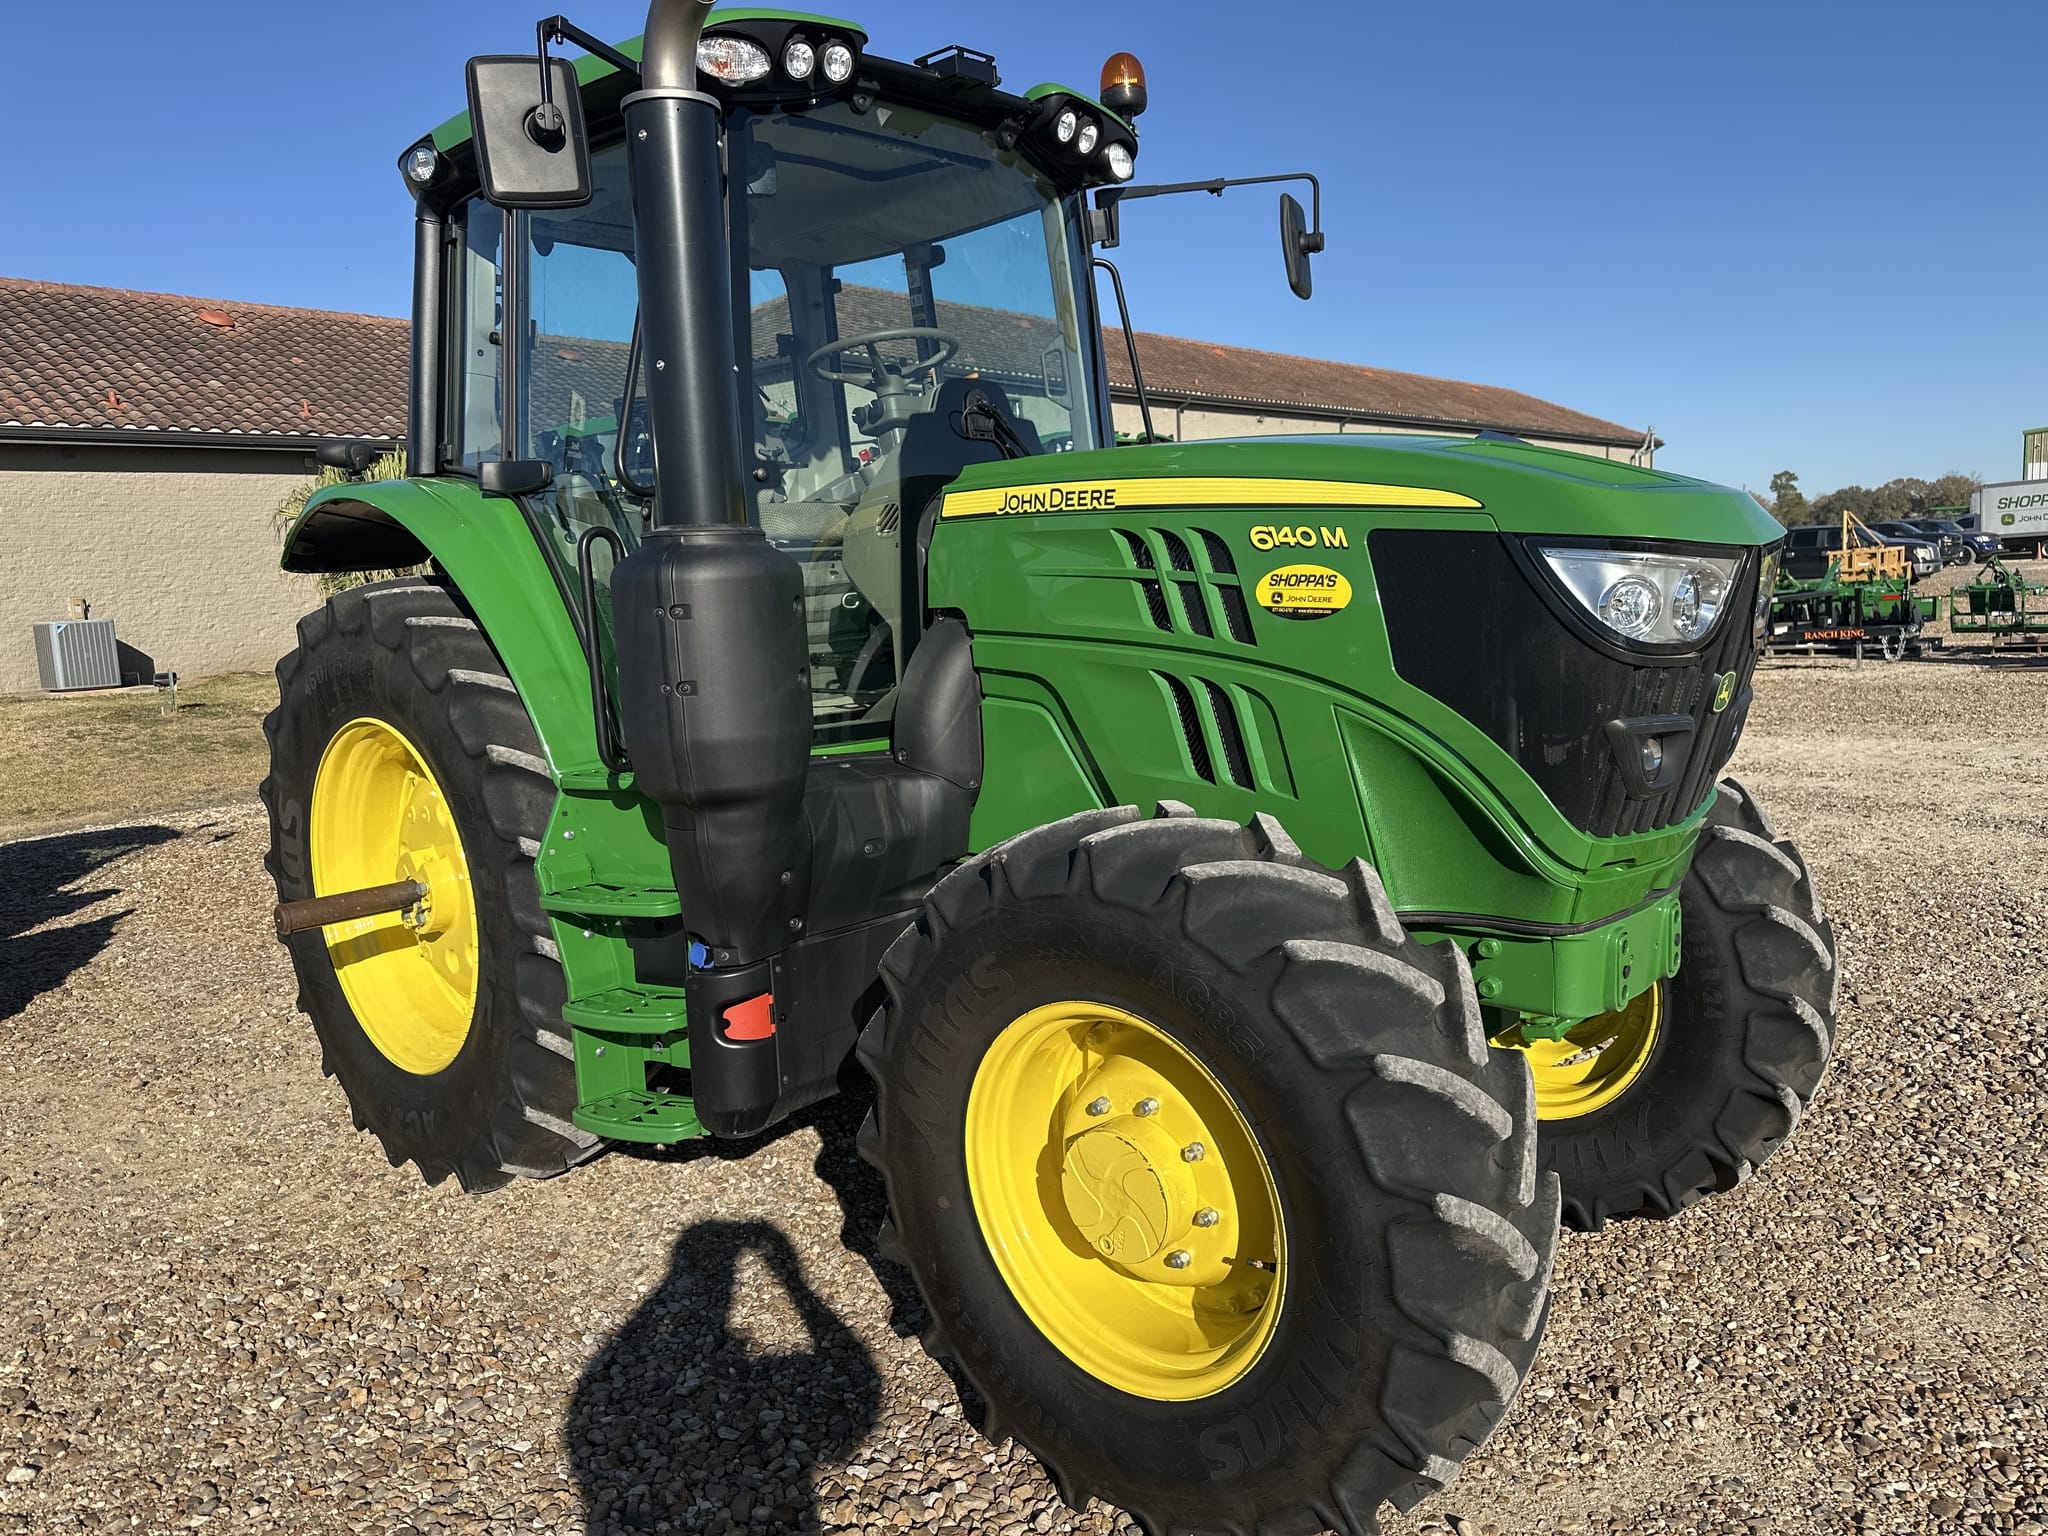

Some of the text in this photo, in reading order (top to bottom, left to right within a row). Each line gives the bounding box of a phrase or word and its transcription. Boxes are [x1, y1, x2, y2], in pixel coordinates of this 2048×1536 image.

[998, 488, 1116, 511] JOHN DEERE
[2018, 513, 2042, 522] JOHN
[1249, 525, 1349, 551] 6140 M
[1269, 573, 1338, 588] SHOPPA'S
[1285, 594, 1334, 603] JOHN DEERE
[1804, 628, 1865, 640] RANCH KING
